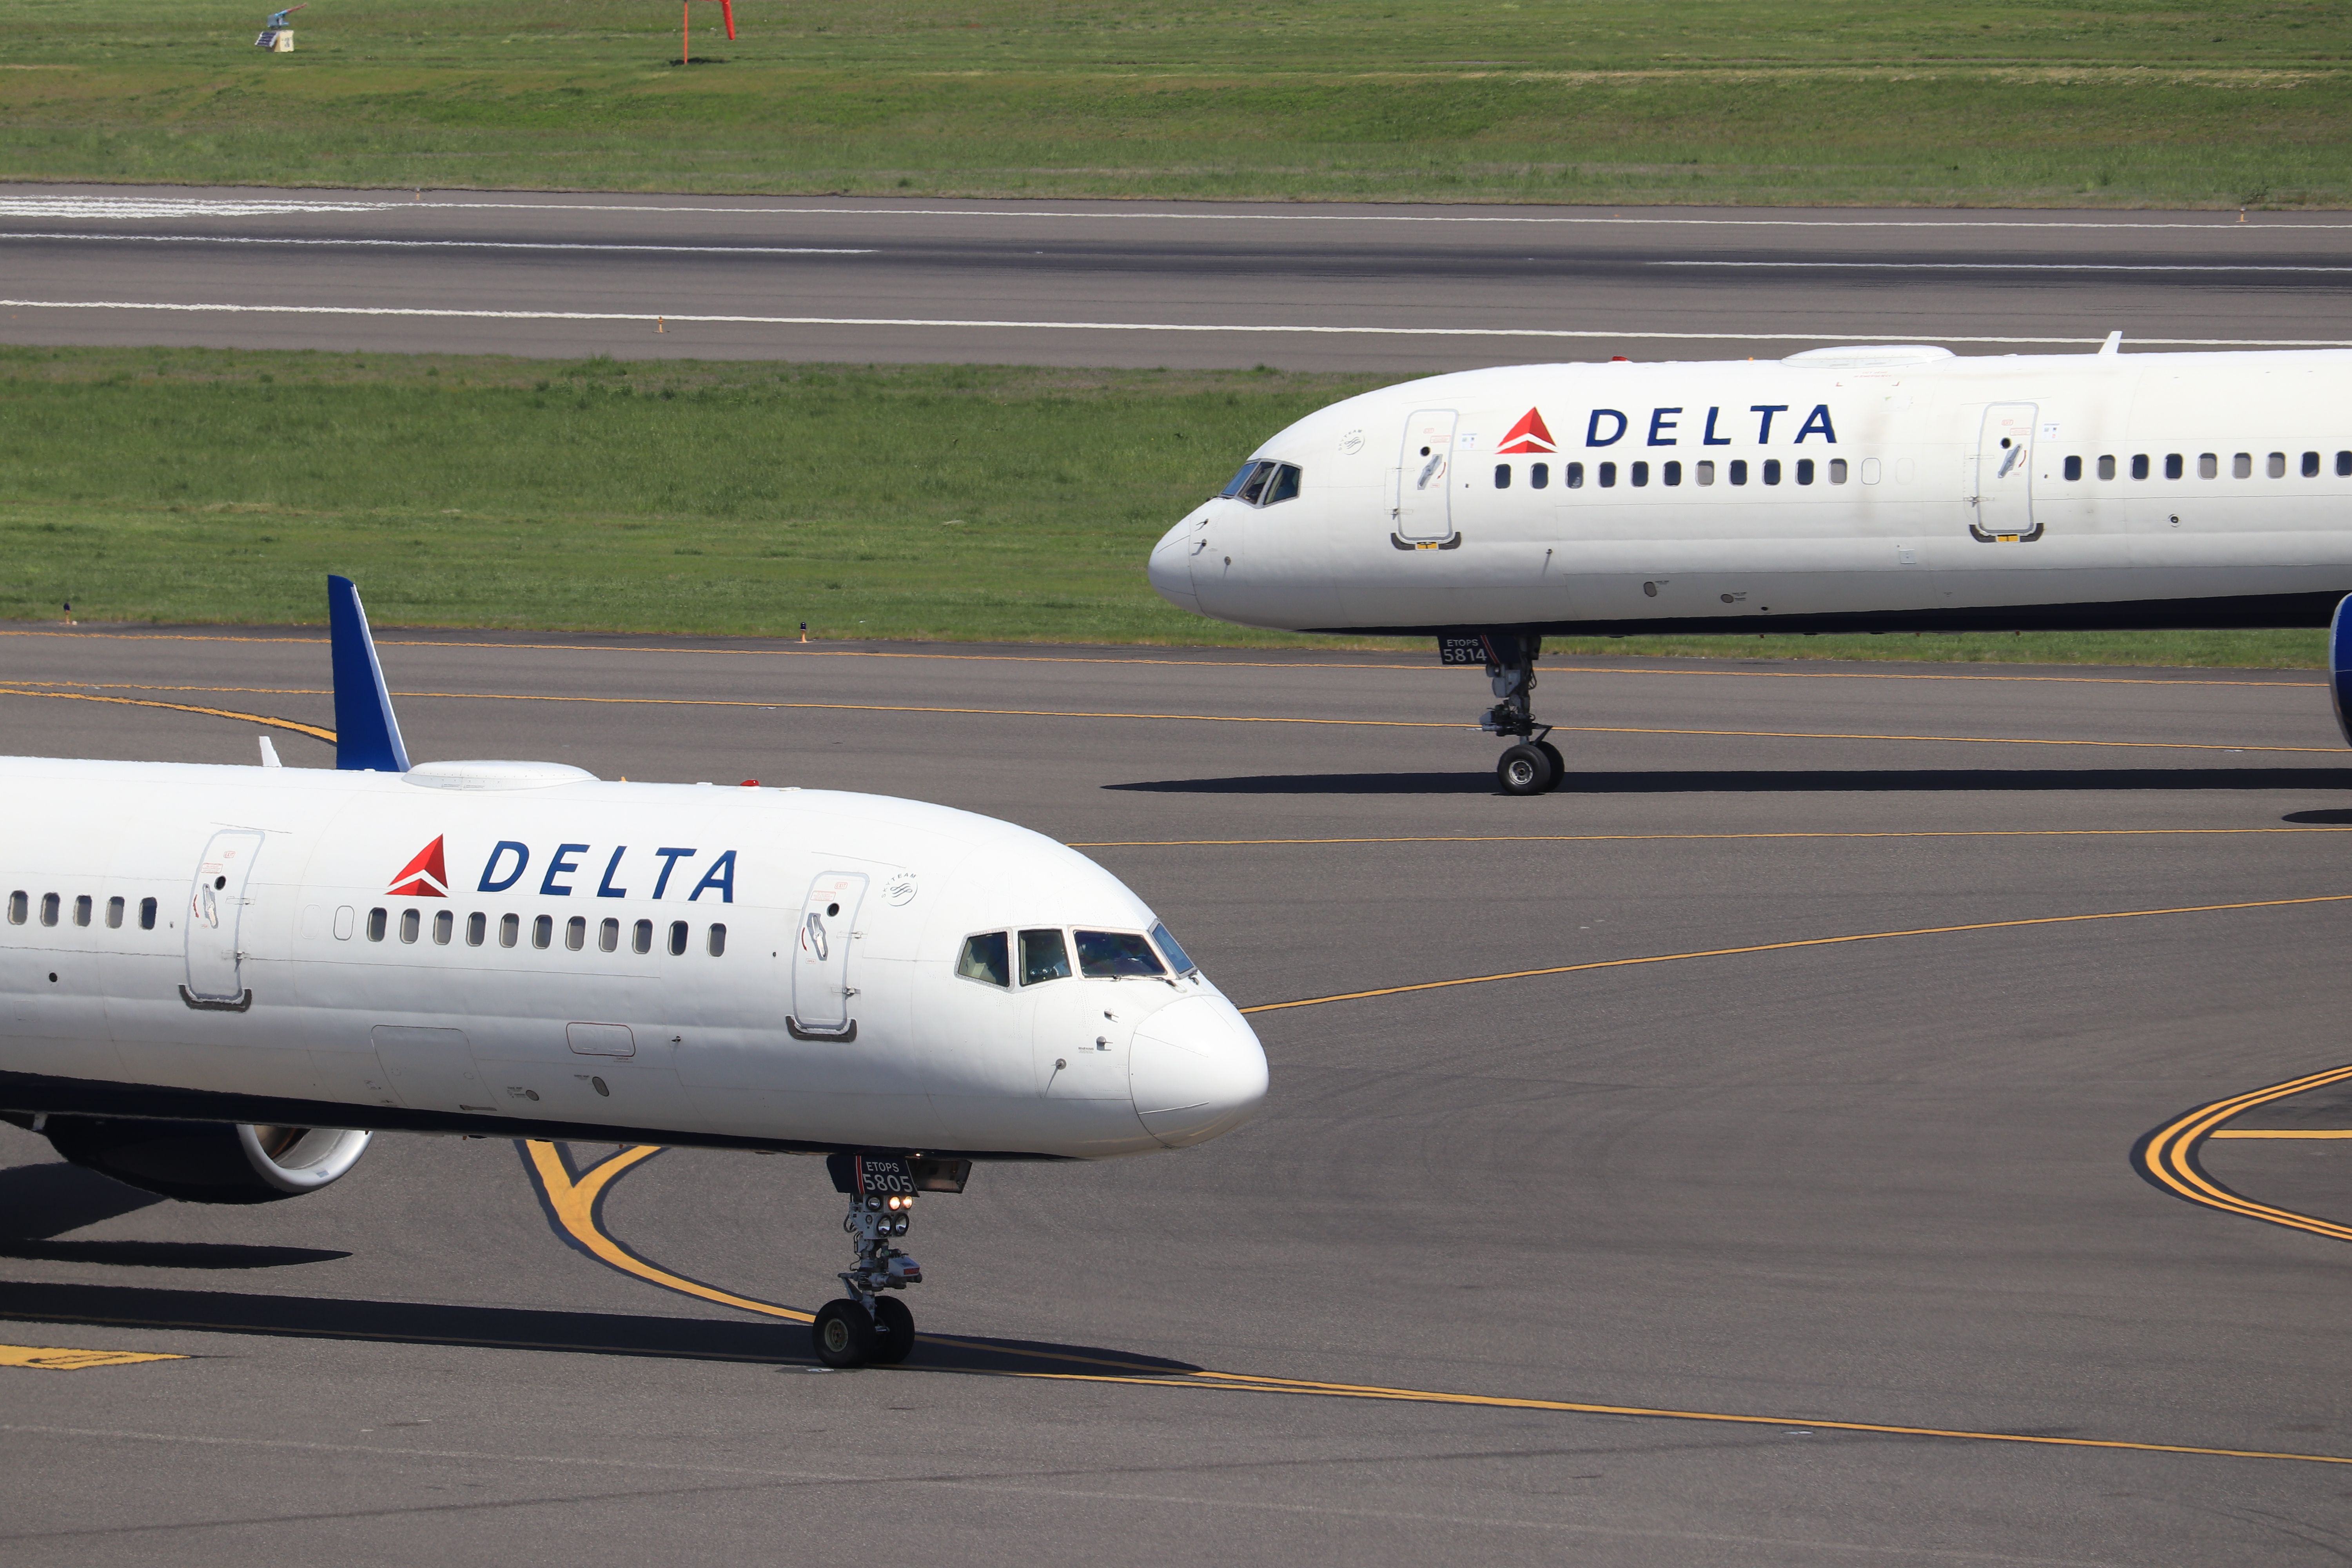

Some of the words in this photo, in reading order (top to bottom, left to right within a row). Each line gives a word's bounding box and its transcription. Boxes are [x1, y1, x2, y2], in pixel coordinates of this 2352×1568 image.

[1586, 405, 1837, 447] DELTA
[1444, 648, 1487, 662] 5814
[477, 841, 737, 903] DELTA
[881, 873, 916, 898] SKYTEAM
[866, 1161, 900, 1172] ETOPS
[862, 1174, 913, 1192] 5805
